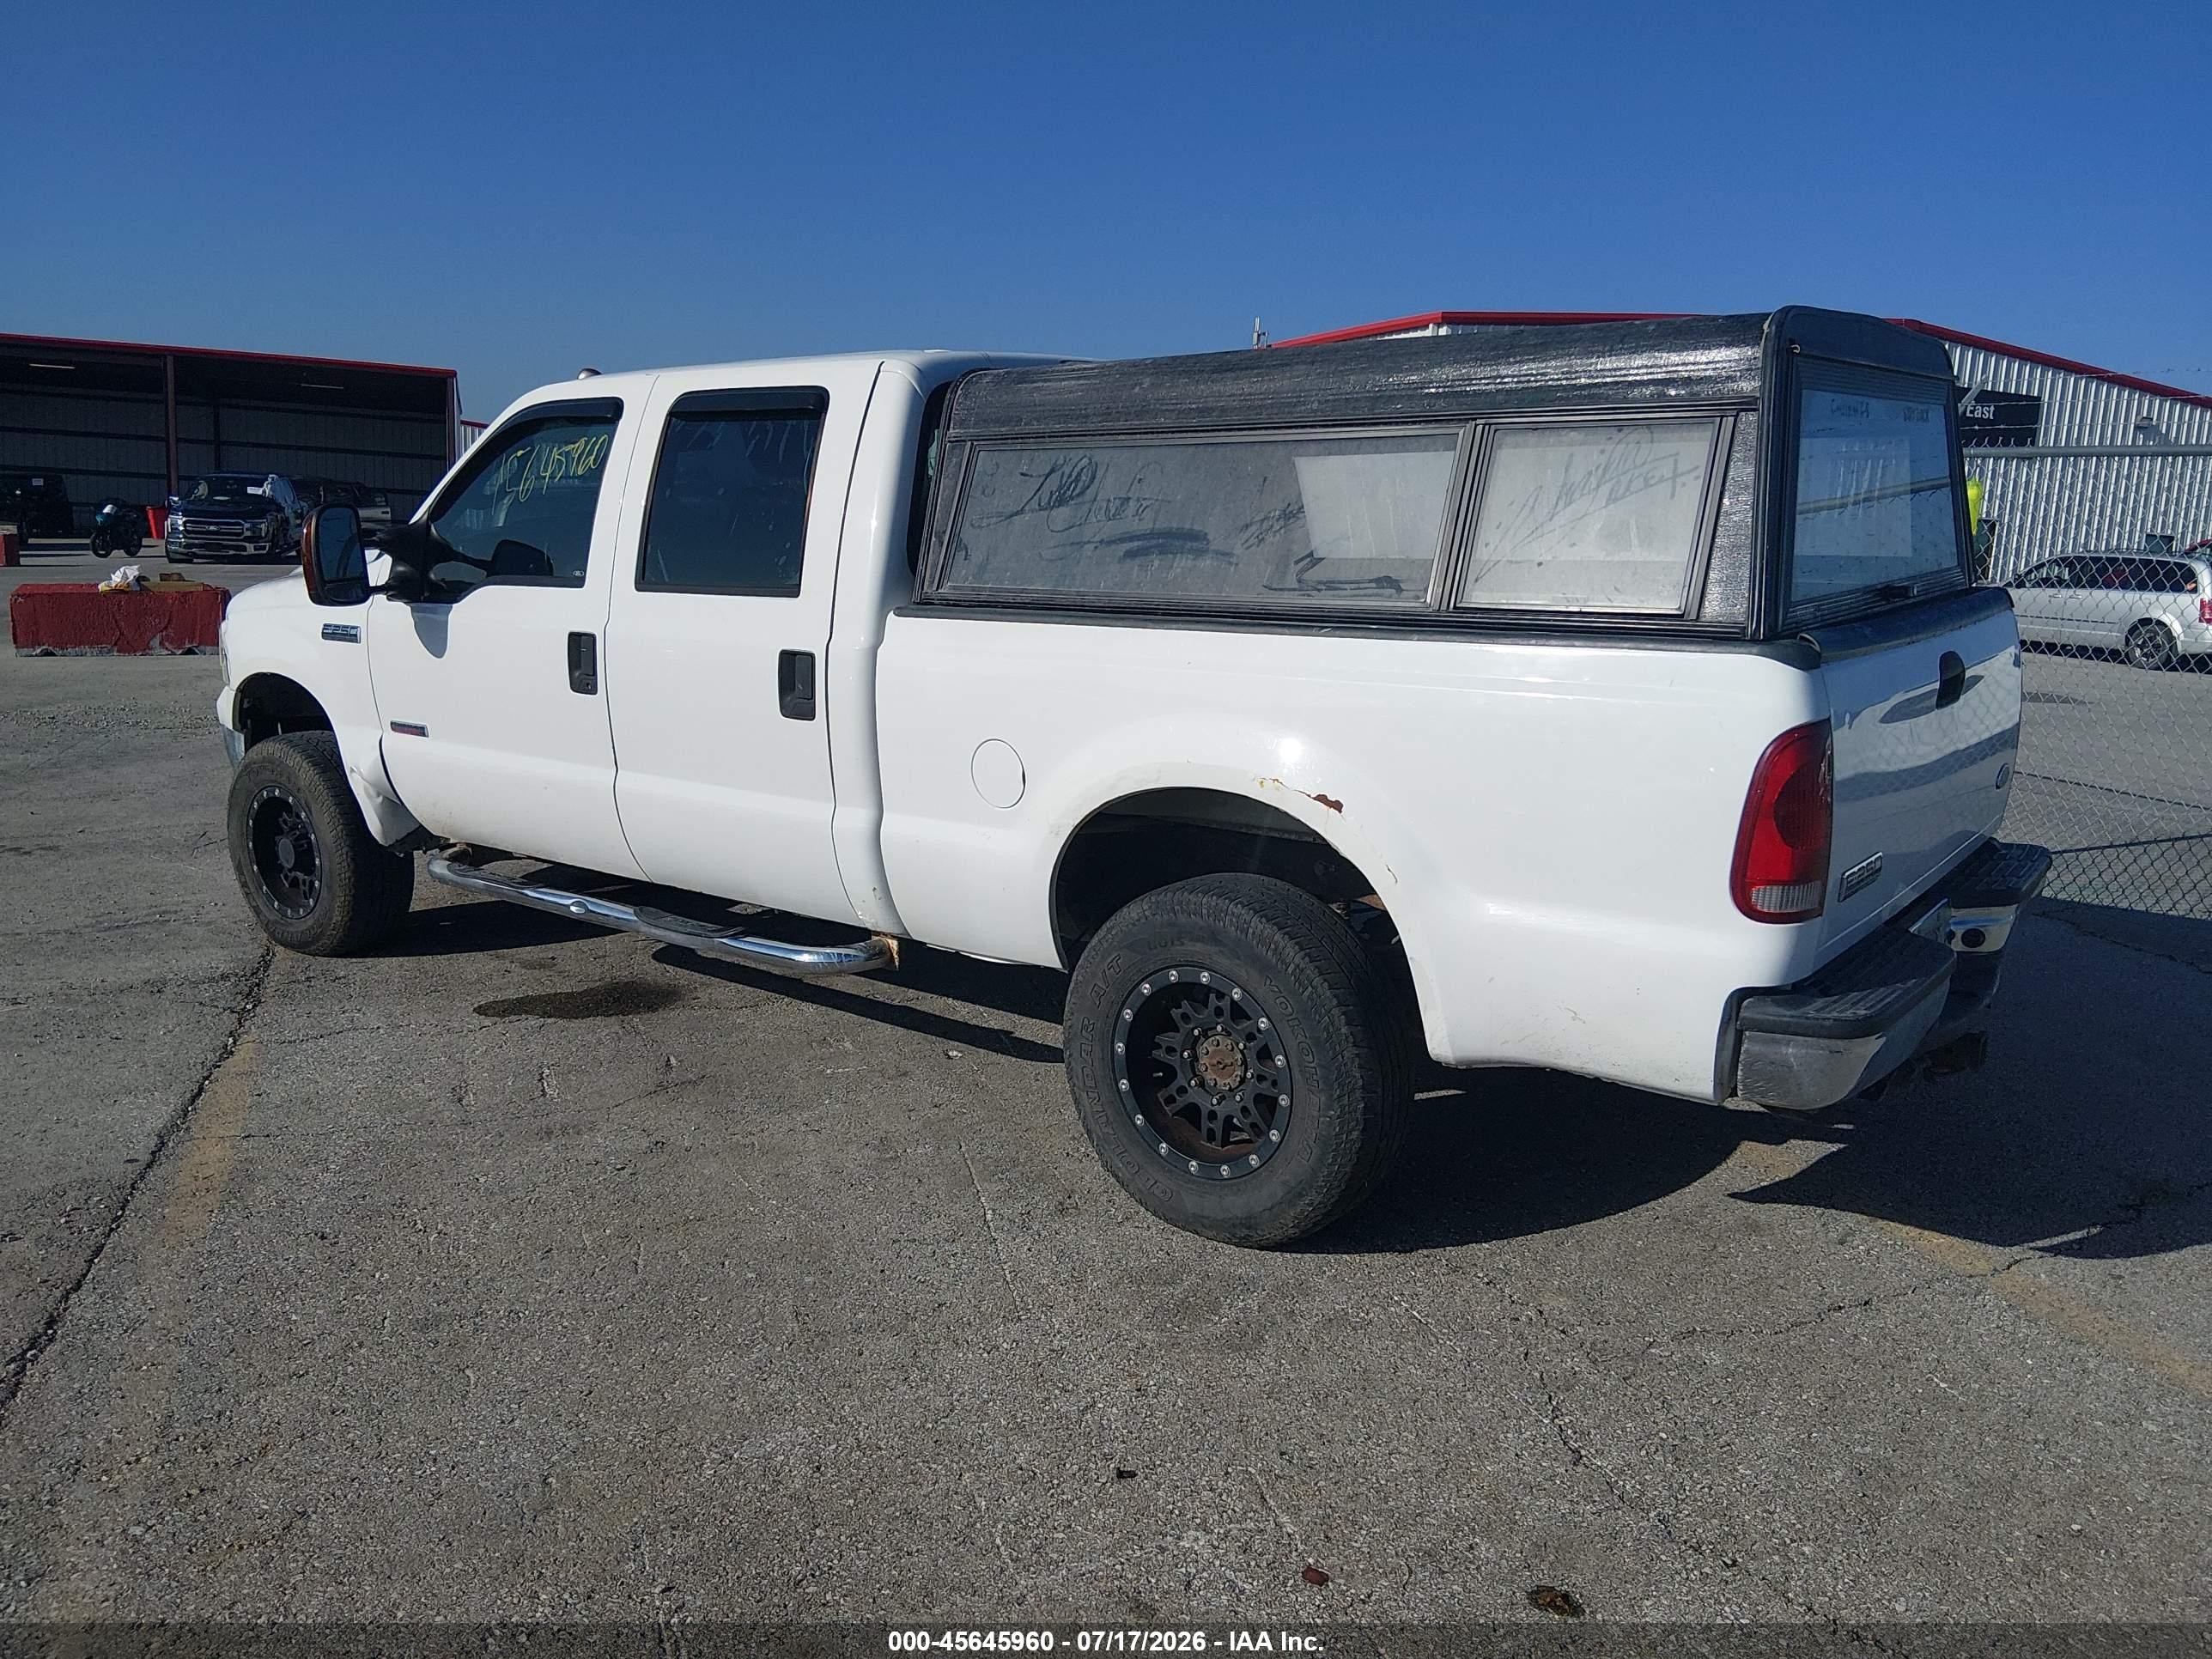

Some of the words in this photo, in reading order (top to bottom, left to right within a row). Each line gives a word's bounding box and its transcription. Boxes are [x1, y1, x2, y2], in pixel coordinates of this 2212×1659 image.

[1966, 404, 1996, 420] East
[1089, 952, 1123, 1010] A/T
[1079, 1016, 1173, 1202] GEOLANDAR
[1263, 974, 1322, 1164] YOKOHAMA
